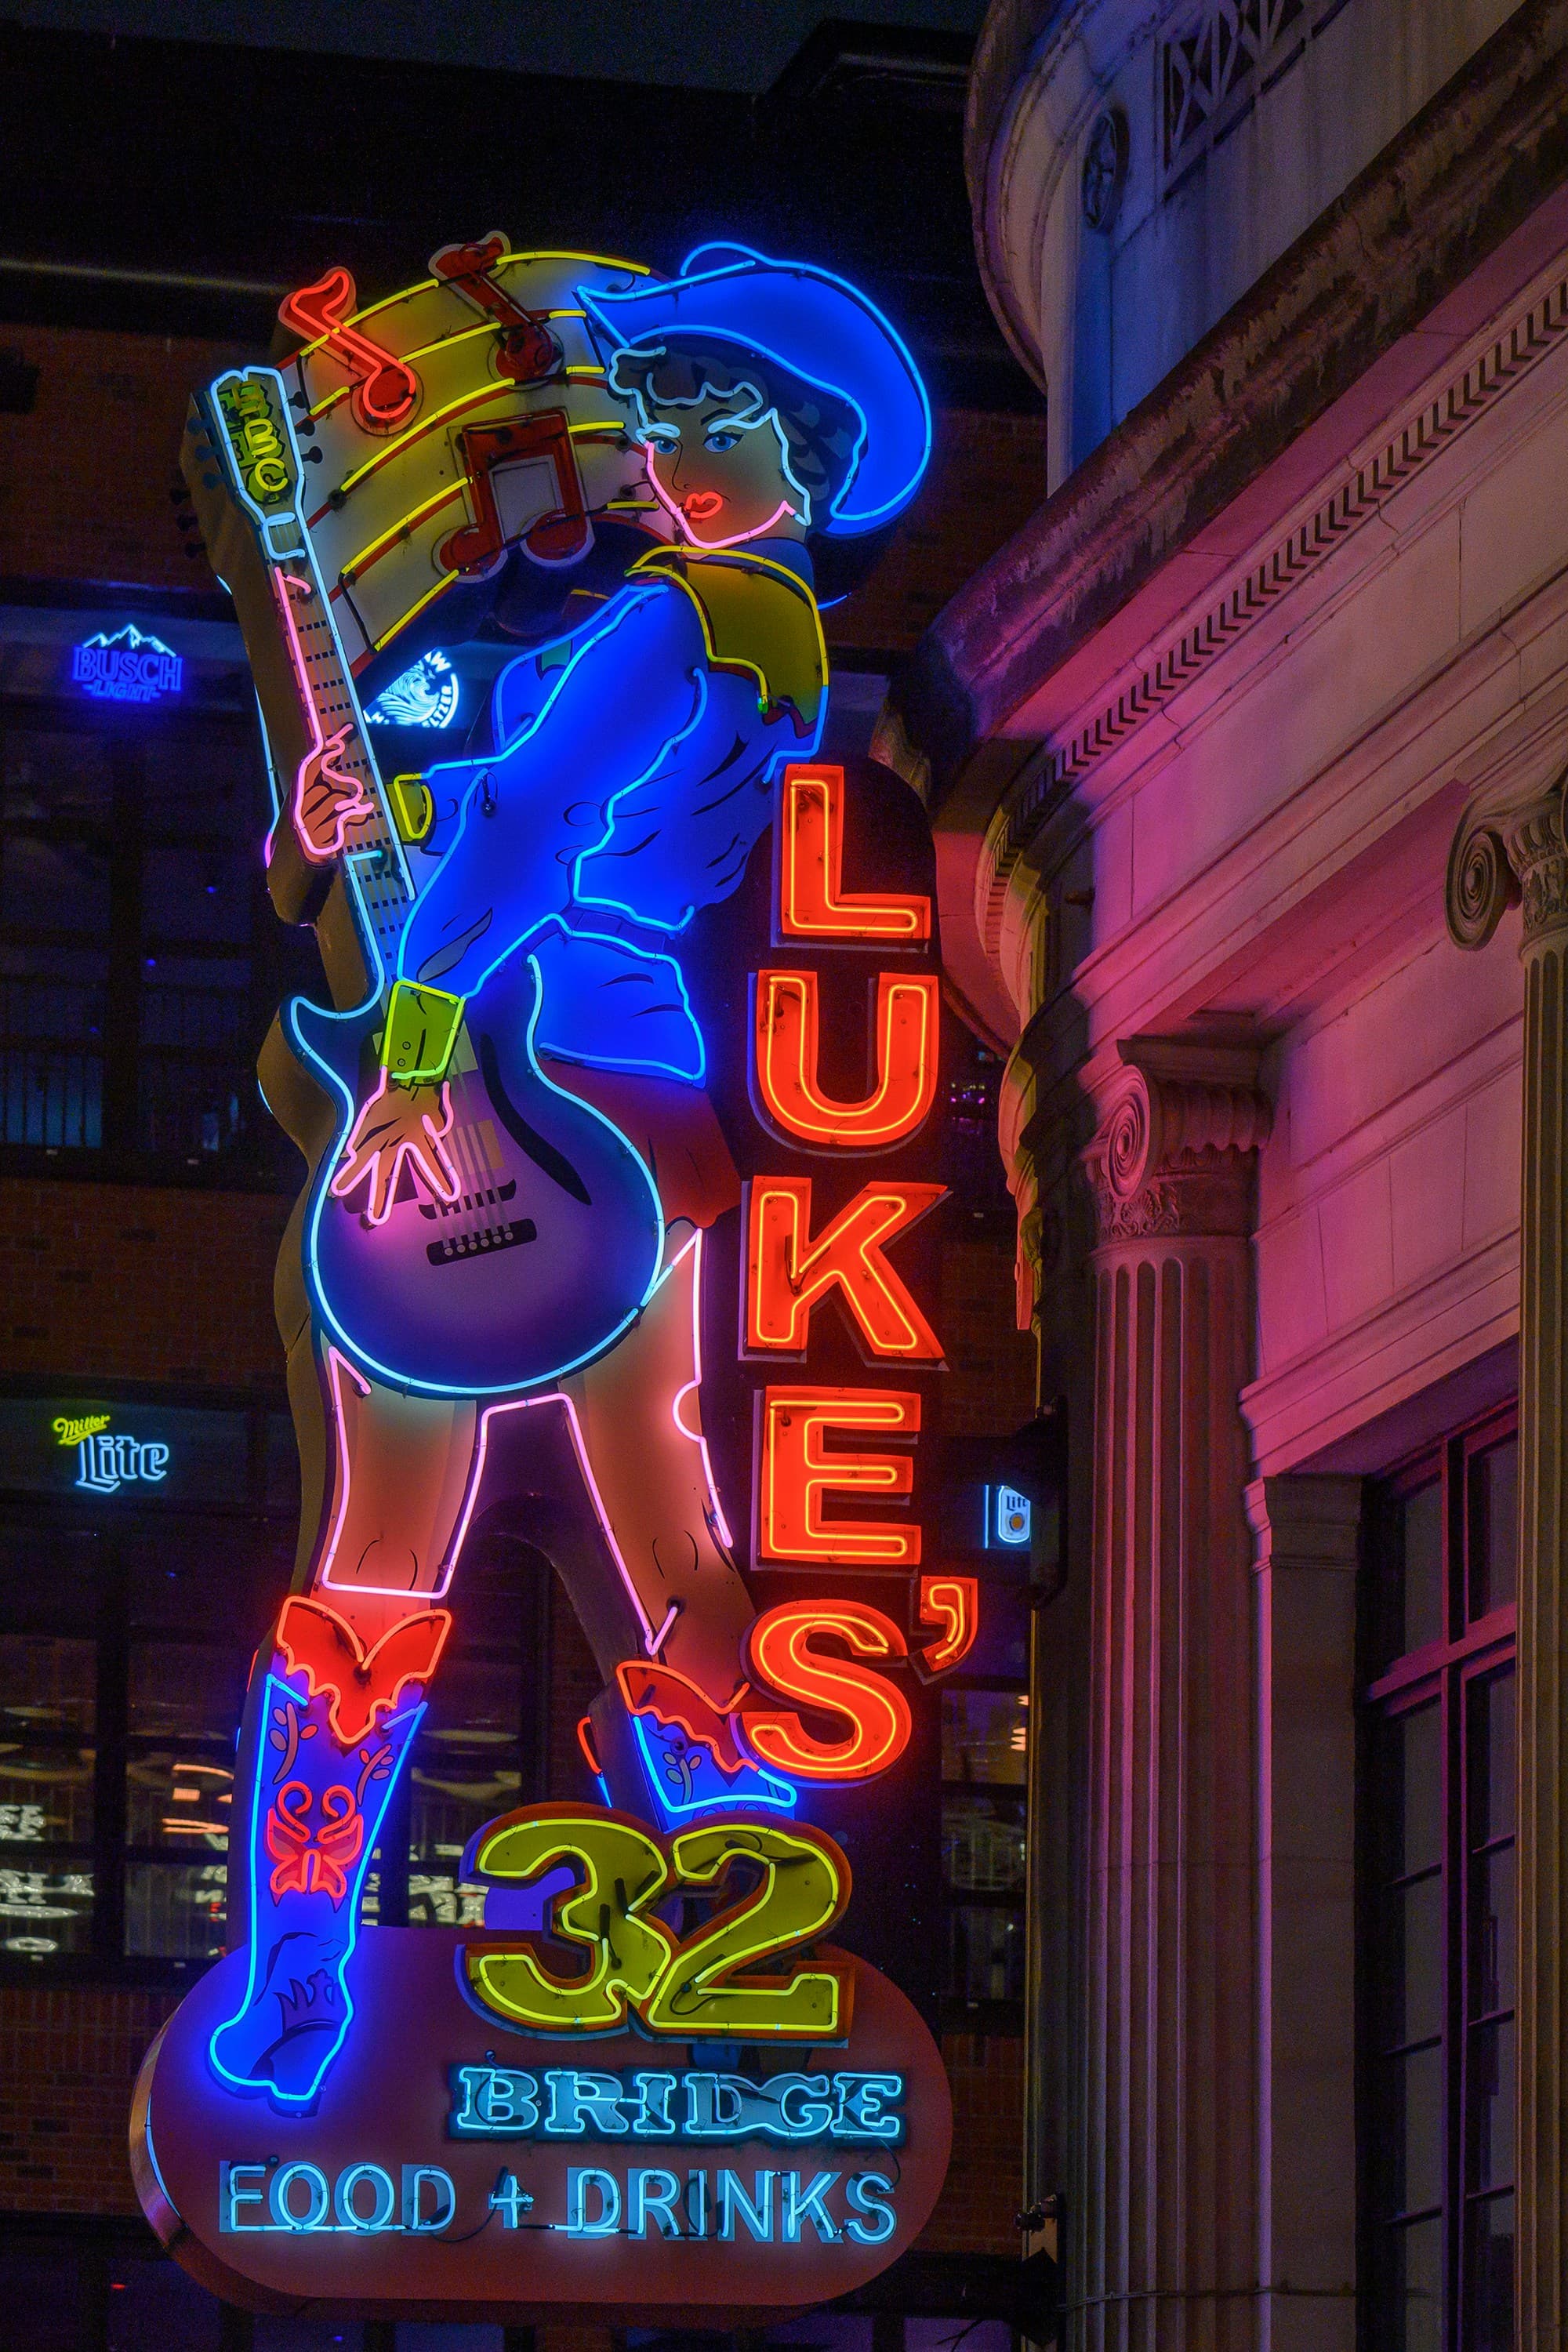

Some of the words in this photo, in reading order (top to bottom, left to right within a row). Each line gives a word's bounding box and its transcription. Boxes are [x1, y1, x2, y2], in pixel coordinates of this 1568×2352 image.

[73, 646, 183, 691] BUSCH
[740, 763, 978, 1780] LUKE'S
[53, 1415, 111, 1444] Miller
[75, 1434, 170, 1493] Lite
[461, 1802, 855, 2040] 32
[456, 2067, 902, 2138] BRIDGE
[220, 2160, 456, 2237] FOOD
[567, 2167, 898, 2244] DRINKS
